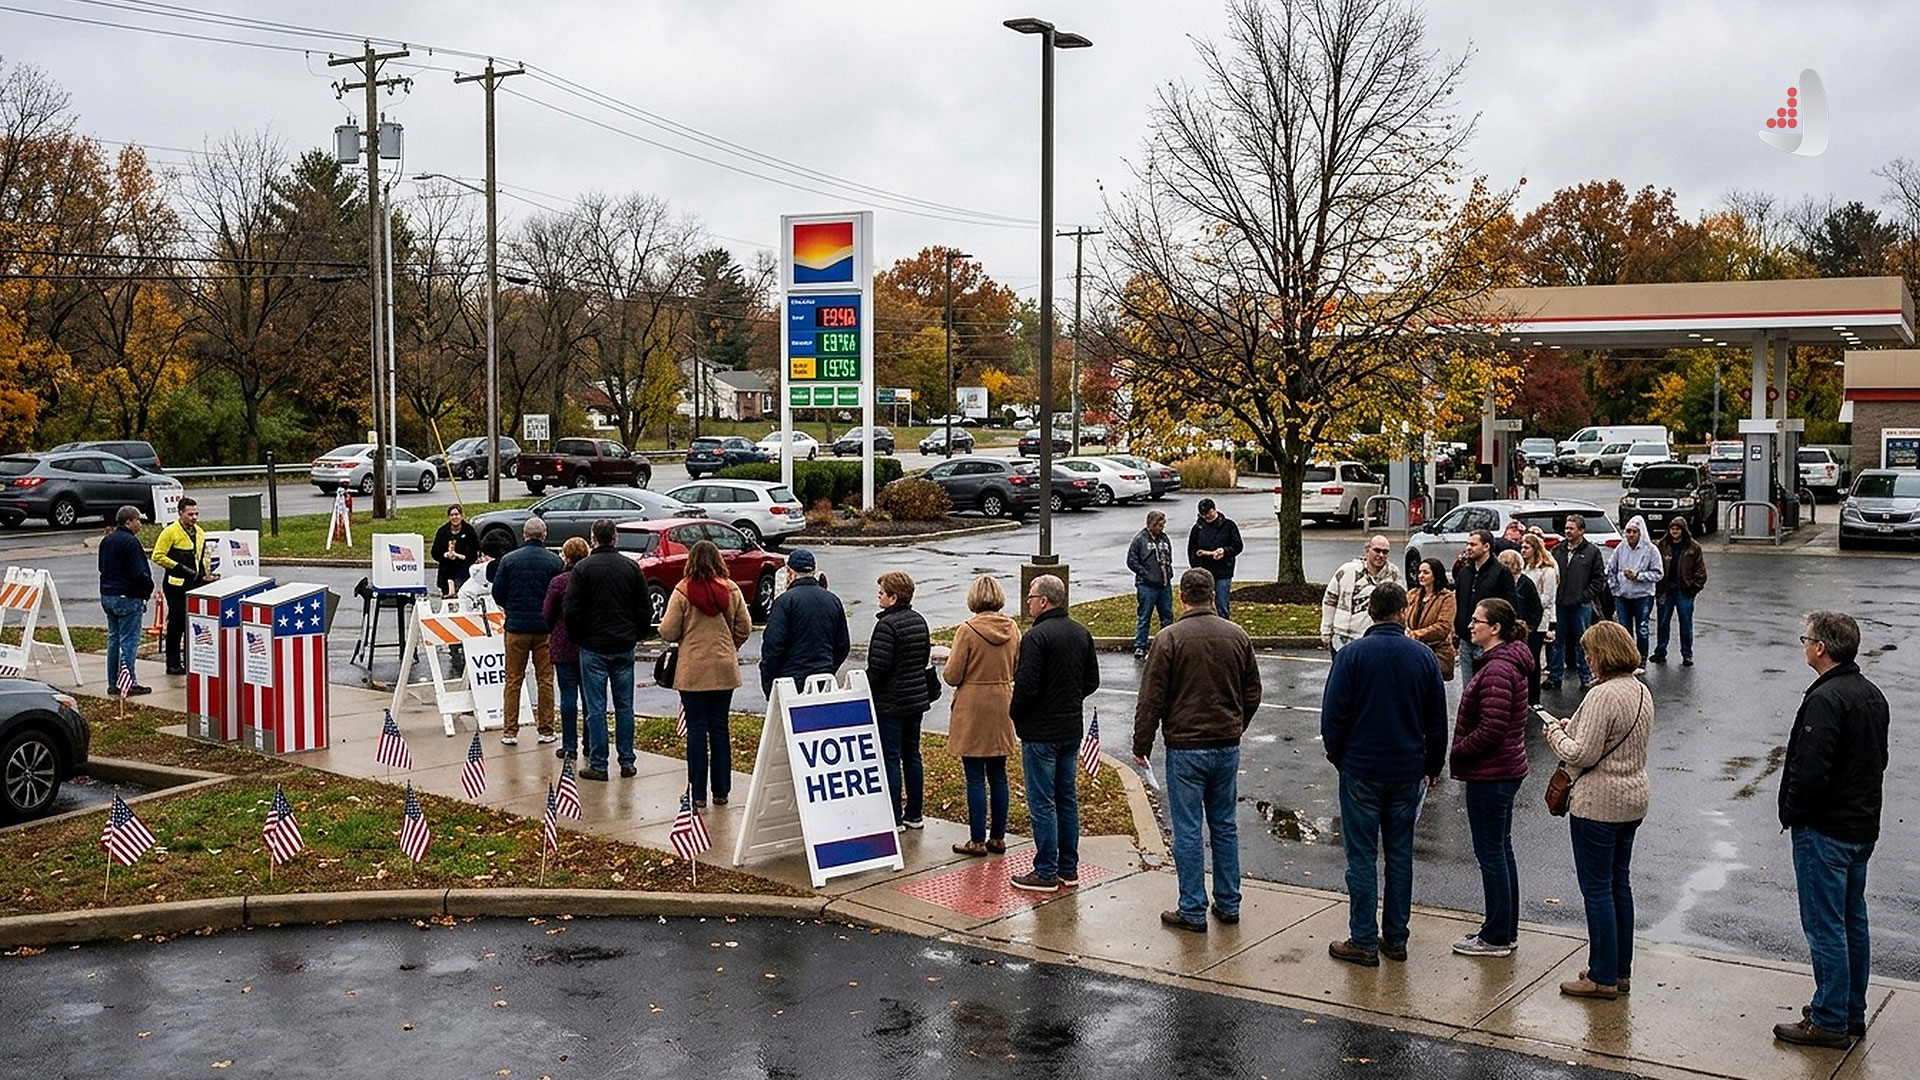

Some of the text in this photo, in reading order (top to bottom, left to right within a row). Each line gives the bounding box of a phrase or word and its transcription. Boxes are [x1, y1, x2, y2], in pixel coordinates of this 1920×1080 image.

[472, 653, 505, 669] VOT
[476, 670, 506, 686] HER
[798, 733, 877, 768] VOTE
[805, 766, 883, 803] HERE
